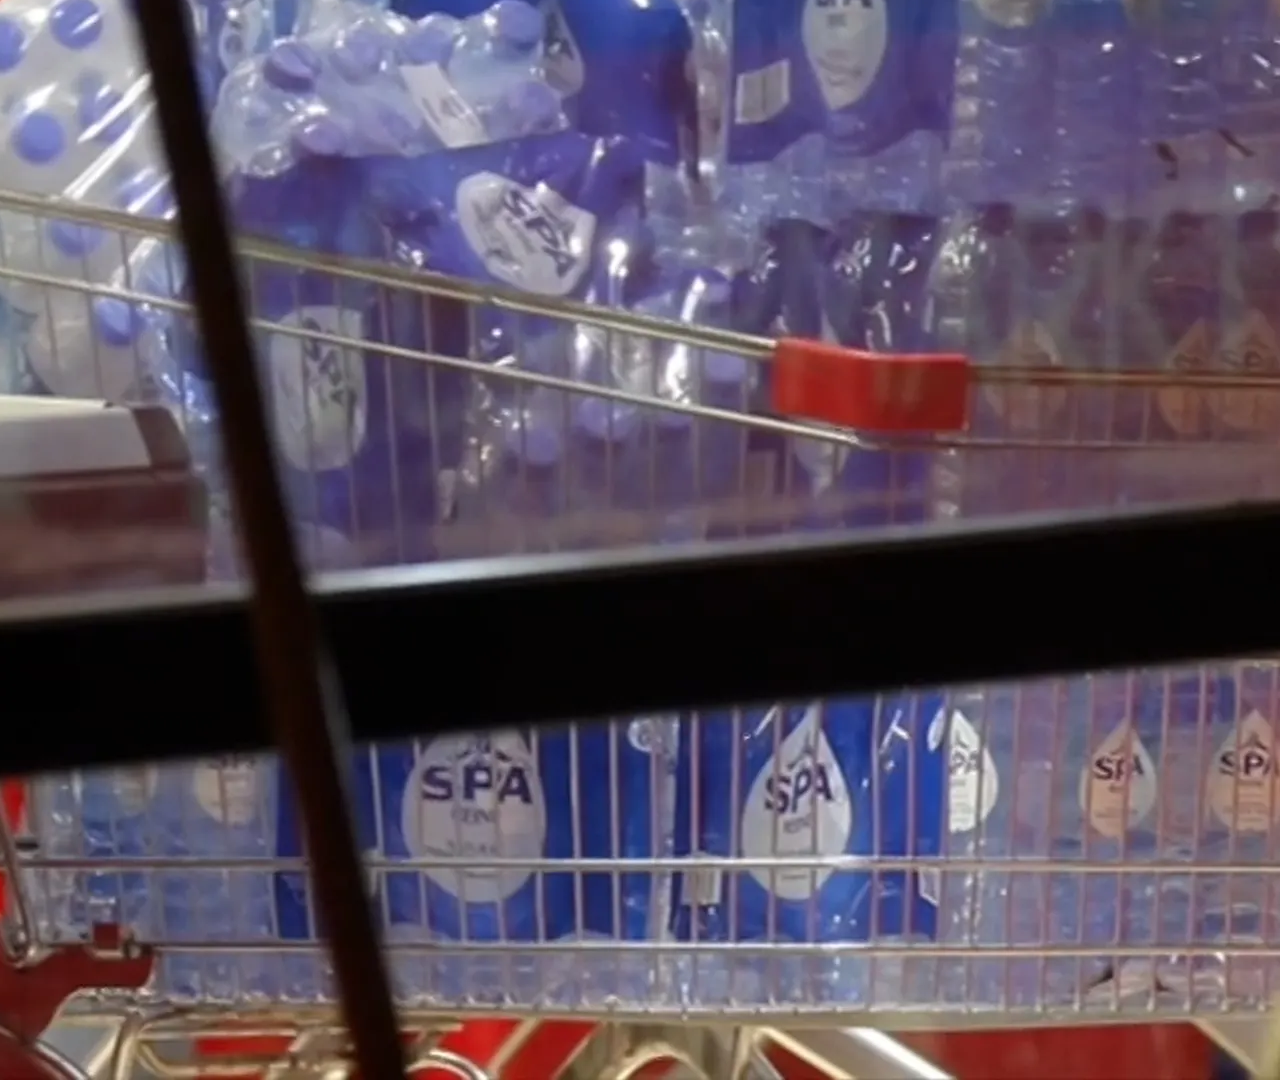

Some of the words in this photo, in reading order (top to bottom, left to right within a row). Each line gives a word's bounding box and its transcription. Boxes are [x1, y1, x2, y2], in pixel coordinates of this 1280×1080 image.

[503, 188, 580, 280] SPA
[421, 764, 533, 805] SPA
[765, 760, 833, 814] SPA
